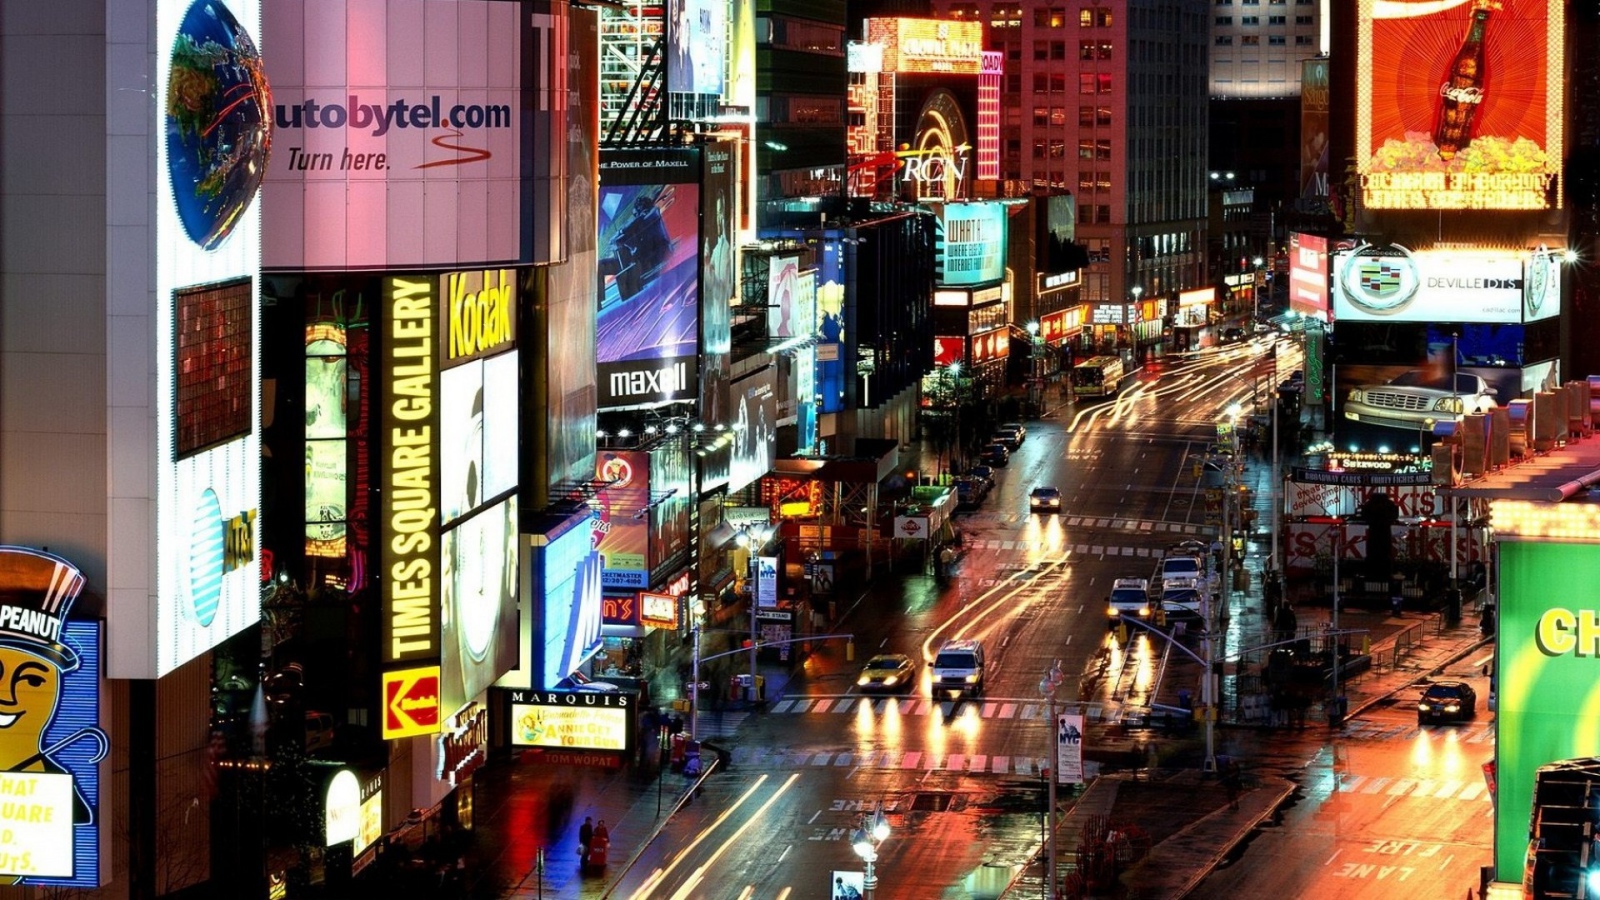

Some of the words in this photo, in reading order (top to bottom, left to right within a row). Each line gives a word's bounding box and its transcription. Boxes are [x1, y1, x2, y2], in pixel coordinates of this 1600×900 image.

[276, 95, 511, 137] utobytel.com
[288, 147, 332, 171] Turn
[340, 147, 391, 171] here.
[902, 157, 968, 182] RCN
[948, 219, 976, 243] WHAT
[1427, 278, 1482, 289] DEVILLE
[1488, 279, 1516, 289] DTS
[449, 269, 511, 359] Kodak
[391, 278, 432, 421] GALLERY
[610, 362, 686, 397] maxell
[1304, 472, 1339, 483] BROADWAY
[1340, 474, 1361, 484] CARES
[391, 425, 435, 554] SQUARE
[759, 570, 775, 579] NYC
[391, 558, 432, 659] TIMES
[0, 605, 61, 641] PEANUT
[511, 691, 627, 706] MARQUIS
[545, 724, 584, 738] ANNIE
[559, 735, 591, 746] YOUR
[1060, 733, 1080, 744] NYC
[545, 754, 570, 764] TOM
[573, 755, 613, 766] WOPAT
[0, 776, 38, 797] HAT
[1362, 839, 1443, 857] FIRE
[1335, 863, 1416, 881] LANE
